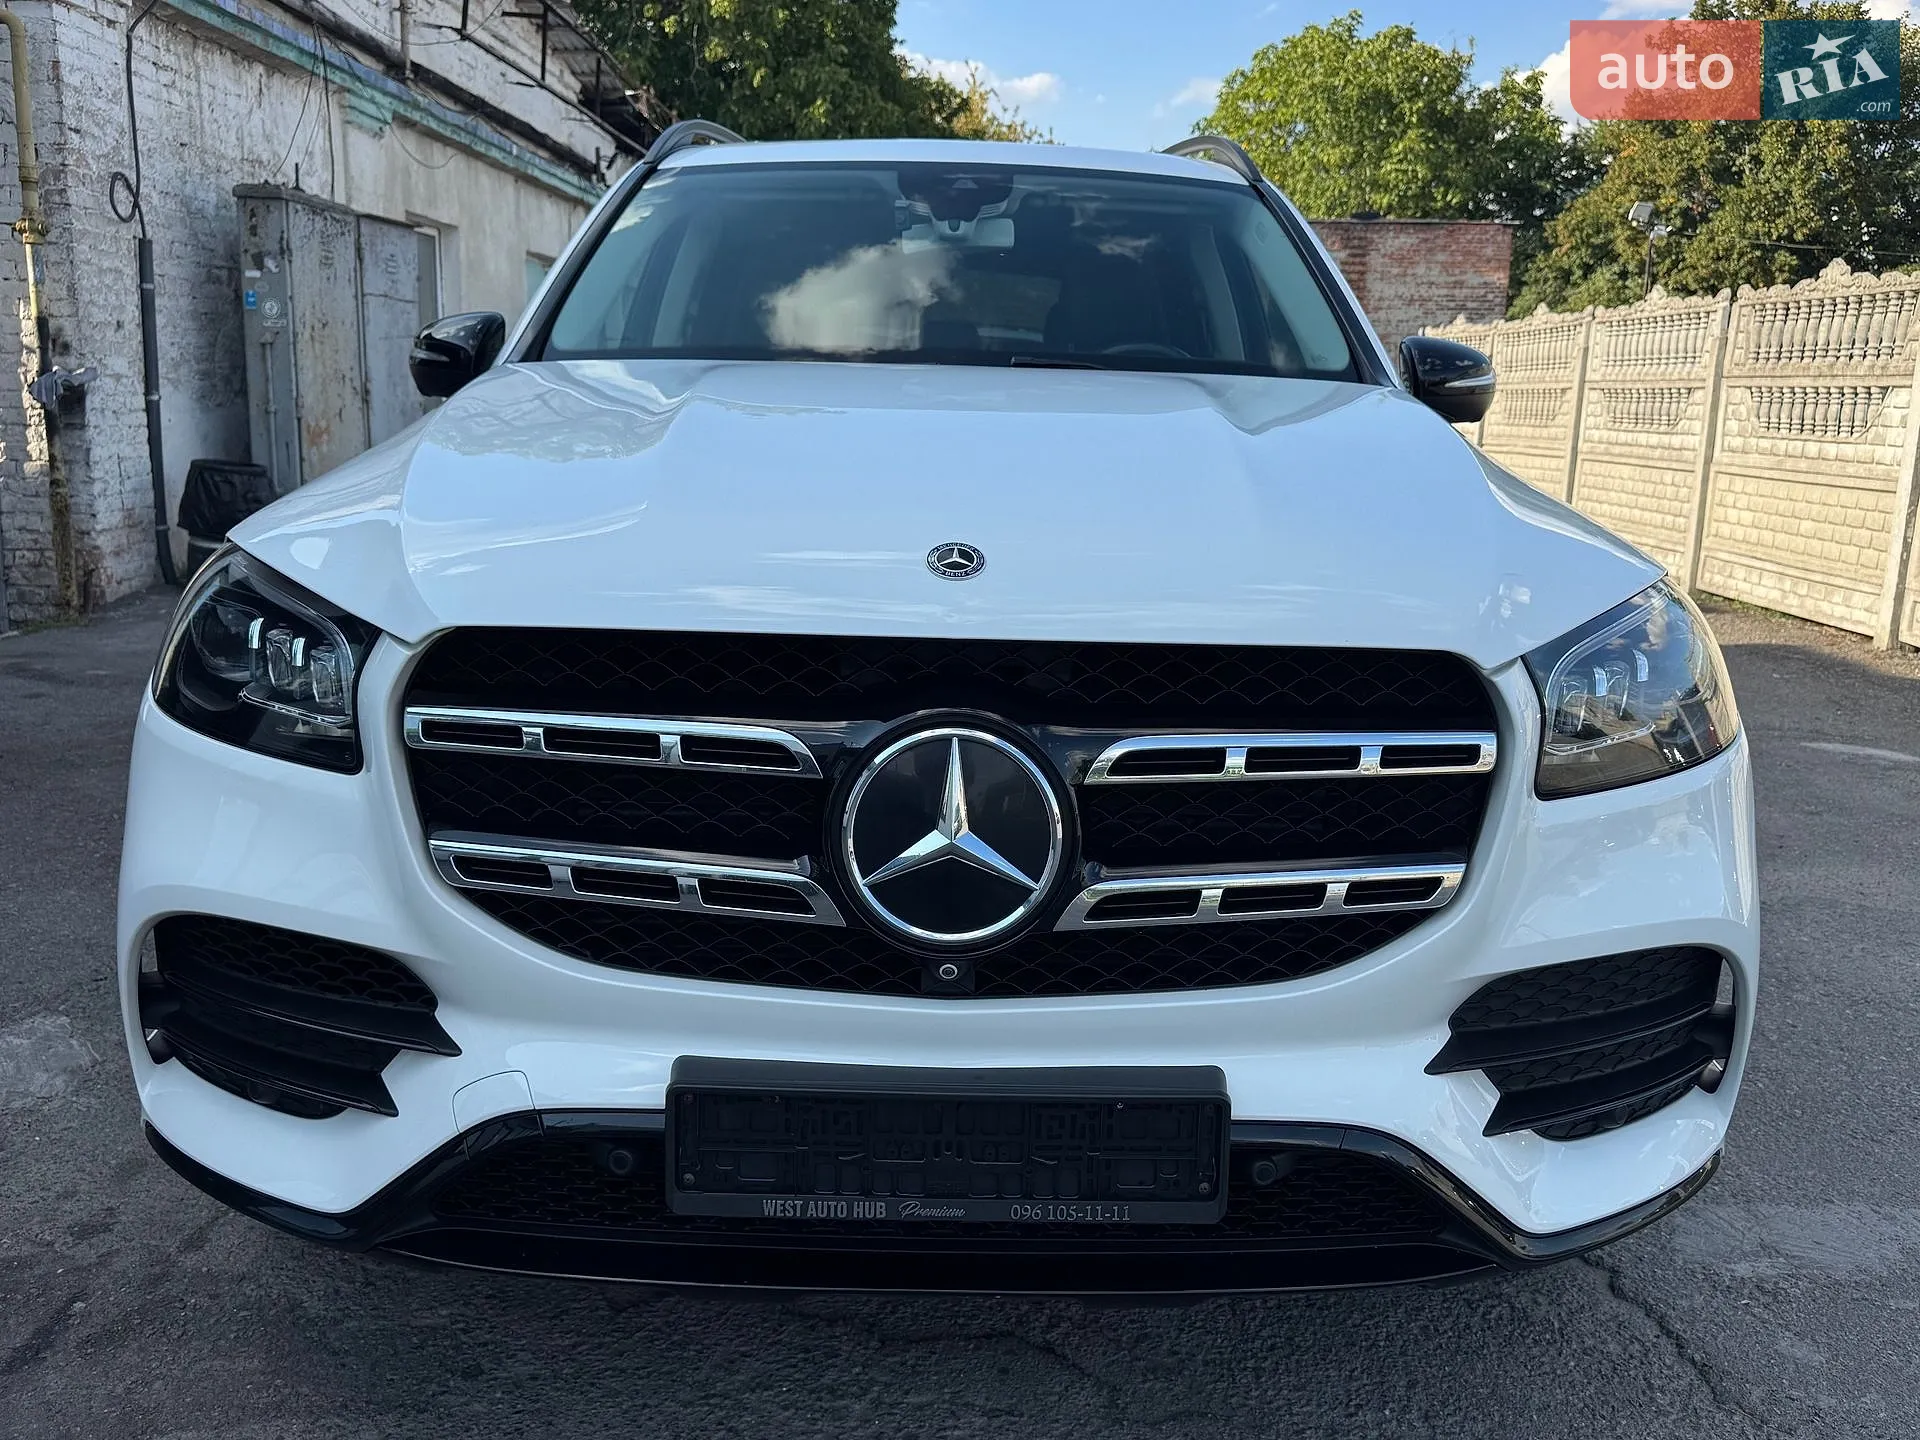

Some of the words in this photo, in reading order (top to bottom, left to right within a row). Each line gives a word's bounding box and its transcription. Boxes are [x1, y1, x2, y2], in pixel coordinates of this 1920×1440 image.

[762, 1199, 804, 1217] WEST
[807, 1200, 848, 1218] AUTO
[853, 1201, 887, 1219] HUB
[898, 1200, 967, 1219] Premium
[1010, 1204, 1043, 1220] 096
[1047, 1204, 1131, 1221] 105-11-11
